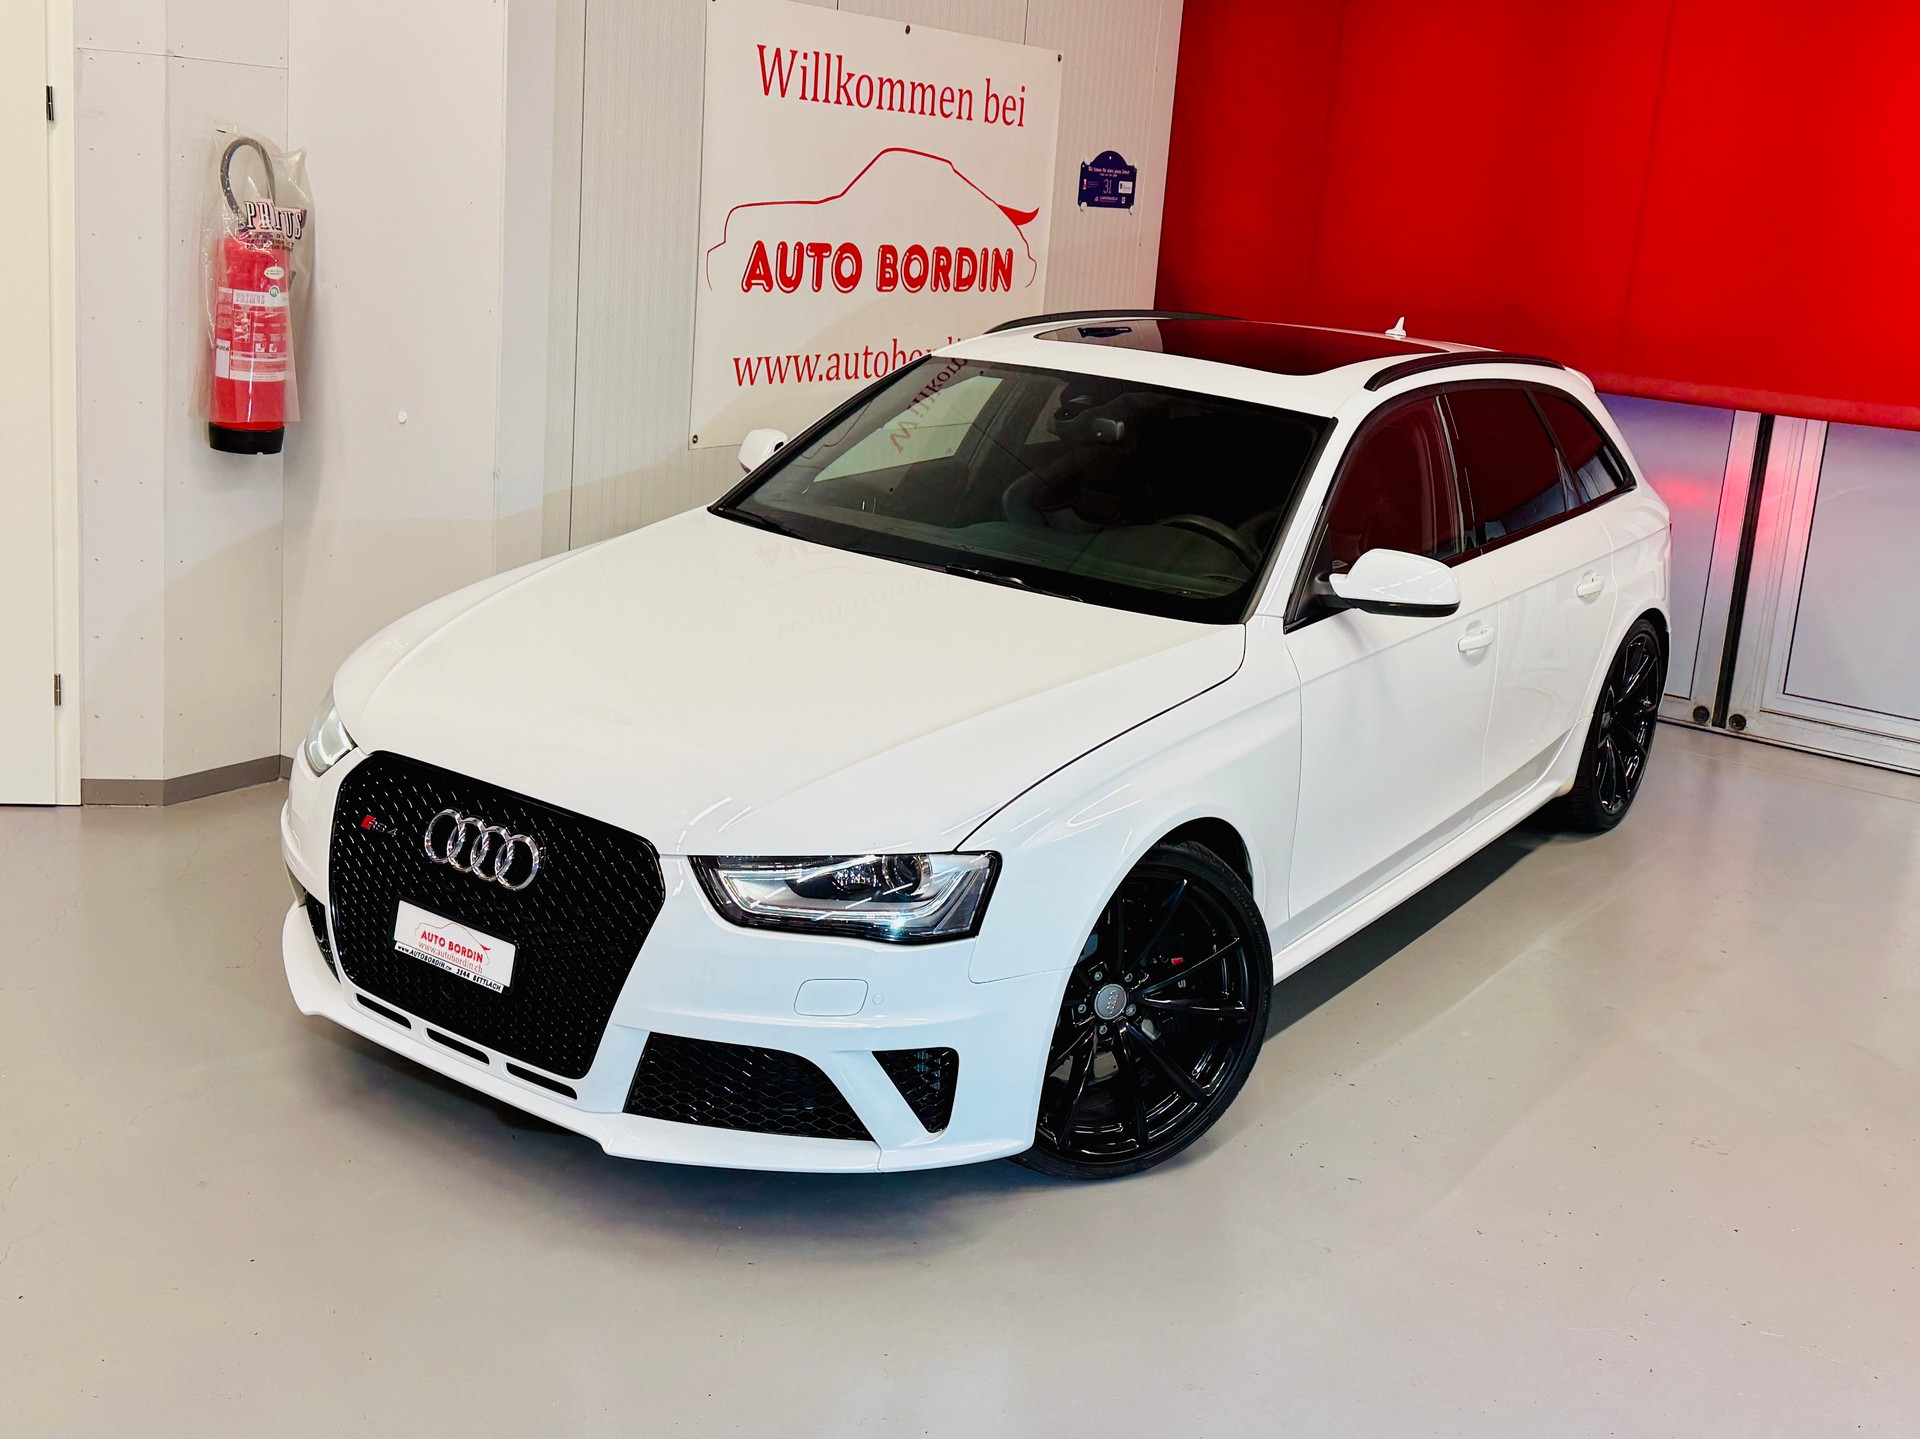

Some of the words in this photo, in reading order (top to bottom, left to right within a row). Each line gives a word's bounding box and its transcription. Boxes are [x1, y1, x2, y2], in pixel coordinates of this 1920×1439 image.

[757, 44, 973, 122] Willkommen
[984, 78, 1027, 127] bei
[741, 240, 863, 294] AUTO
[875, 244, 1015, 294] BORDIN
[418, 941, 483, 974] www.autobordin.ch
[420, 930, 446, 948] AUTO
[448, 941, 484, 964] BORDIN
